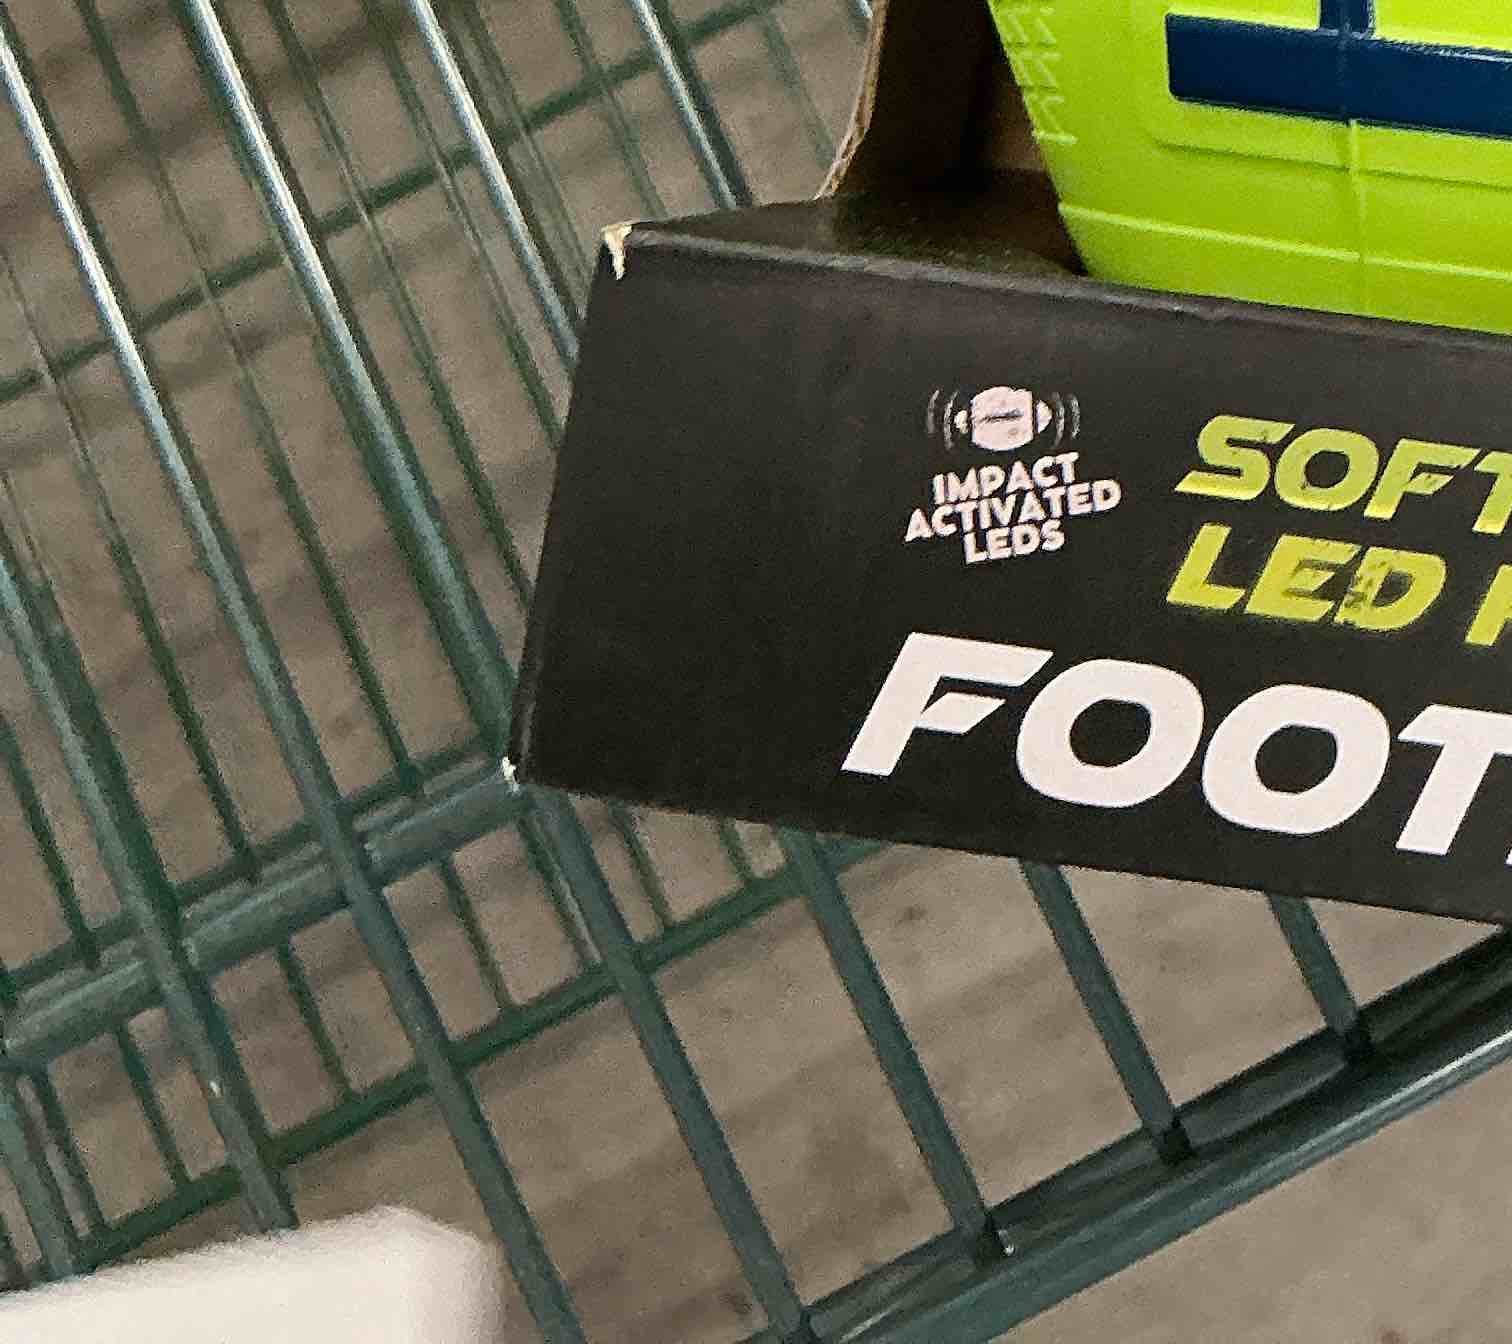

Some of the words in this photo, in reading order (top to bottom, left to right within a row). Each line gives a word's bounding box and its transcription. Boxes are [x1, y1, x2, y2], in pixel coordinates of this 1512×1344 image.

[932, 451, 1079, 505] IMPACT
[904, 479, 1121, 543] ACTIVATED
[963, 519, 1065, 564] LEDS
[1165, 525, 1446, 632] LED
